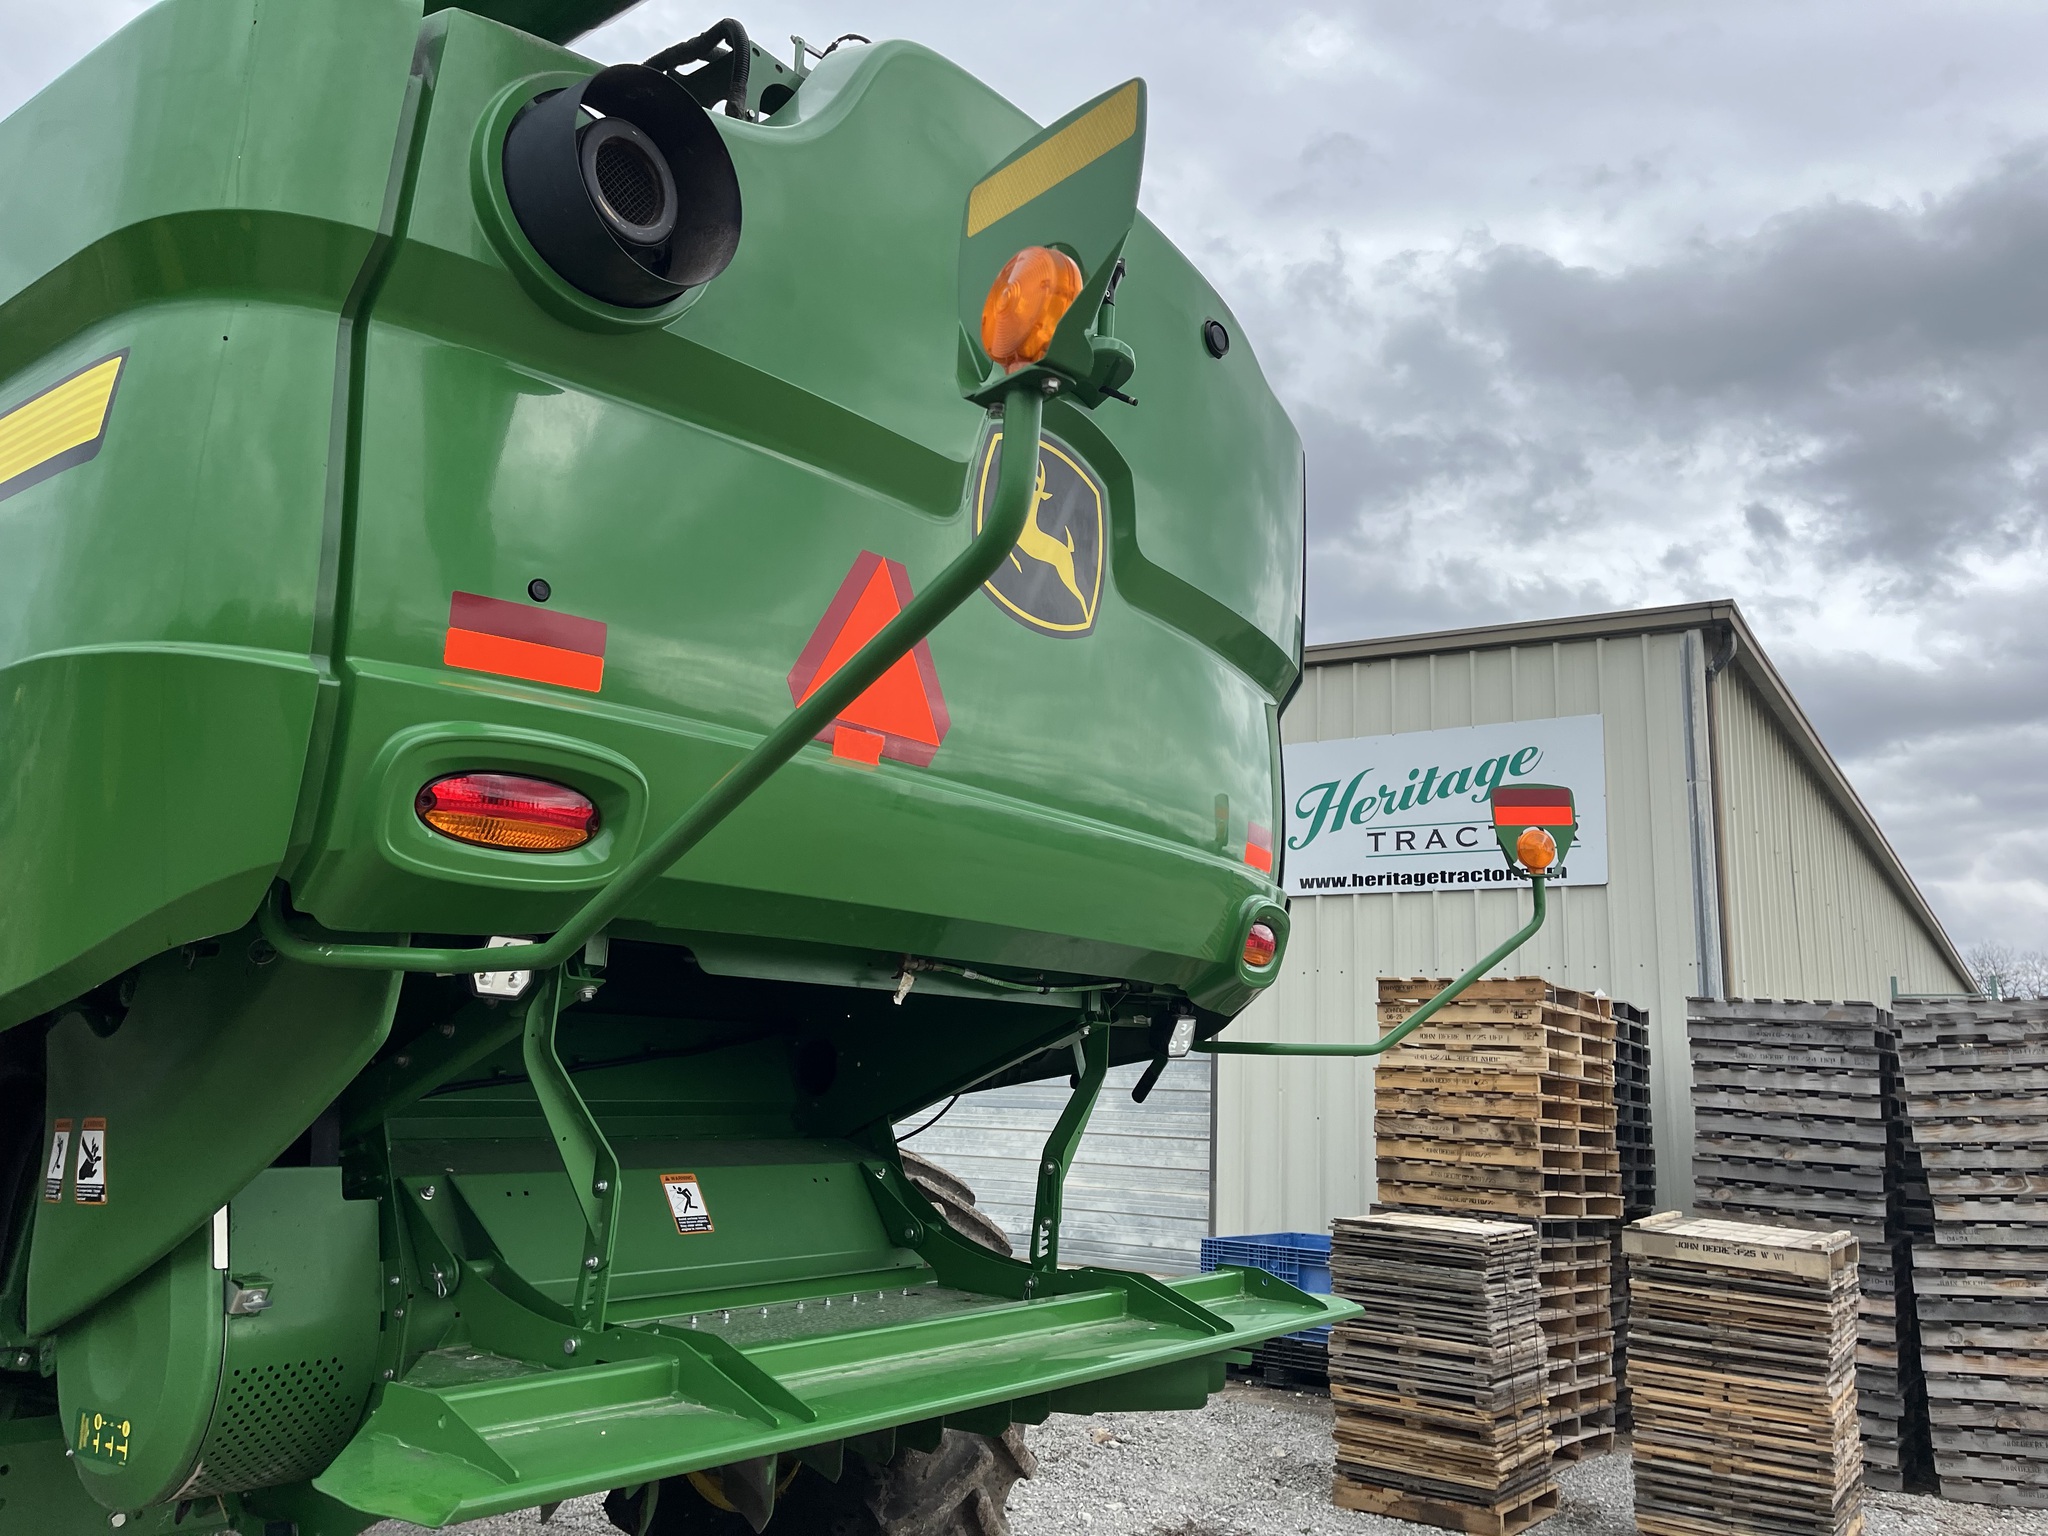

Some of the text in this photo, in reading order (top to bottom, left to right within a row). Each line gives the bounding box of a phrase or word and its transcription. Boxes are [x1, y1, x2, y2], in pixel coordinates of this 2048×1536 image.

[1287, 745, 1543, 851] Heritage
[1366, 822, 1580, 853] TRAC
[1299, 866, 1568, 889] www.heritagetractor.m
[1419, 1032, 1436, 1040] JOHN
[1675, 1241, 1699, 1251] JOHN
[1702, 1243, 1730, 1255] DEERE
[1760, 1251, 1769, 1259] W
